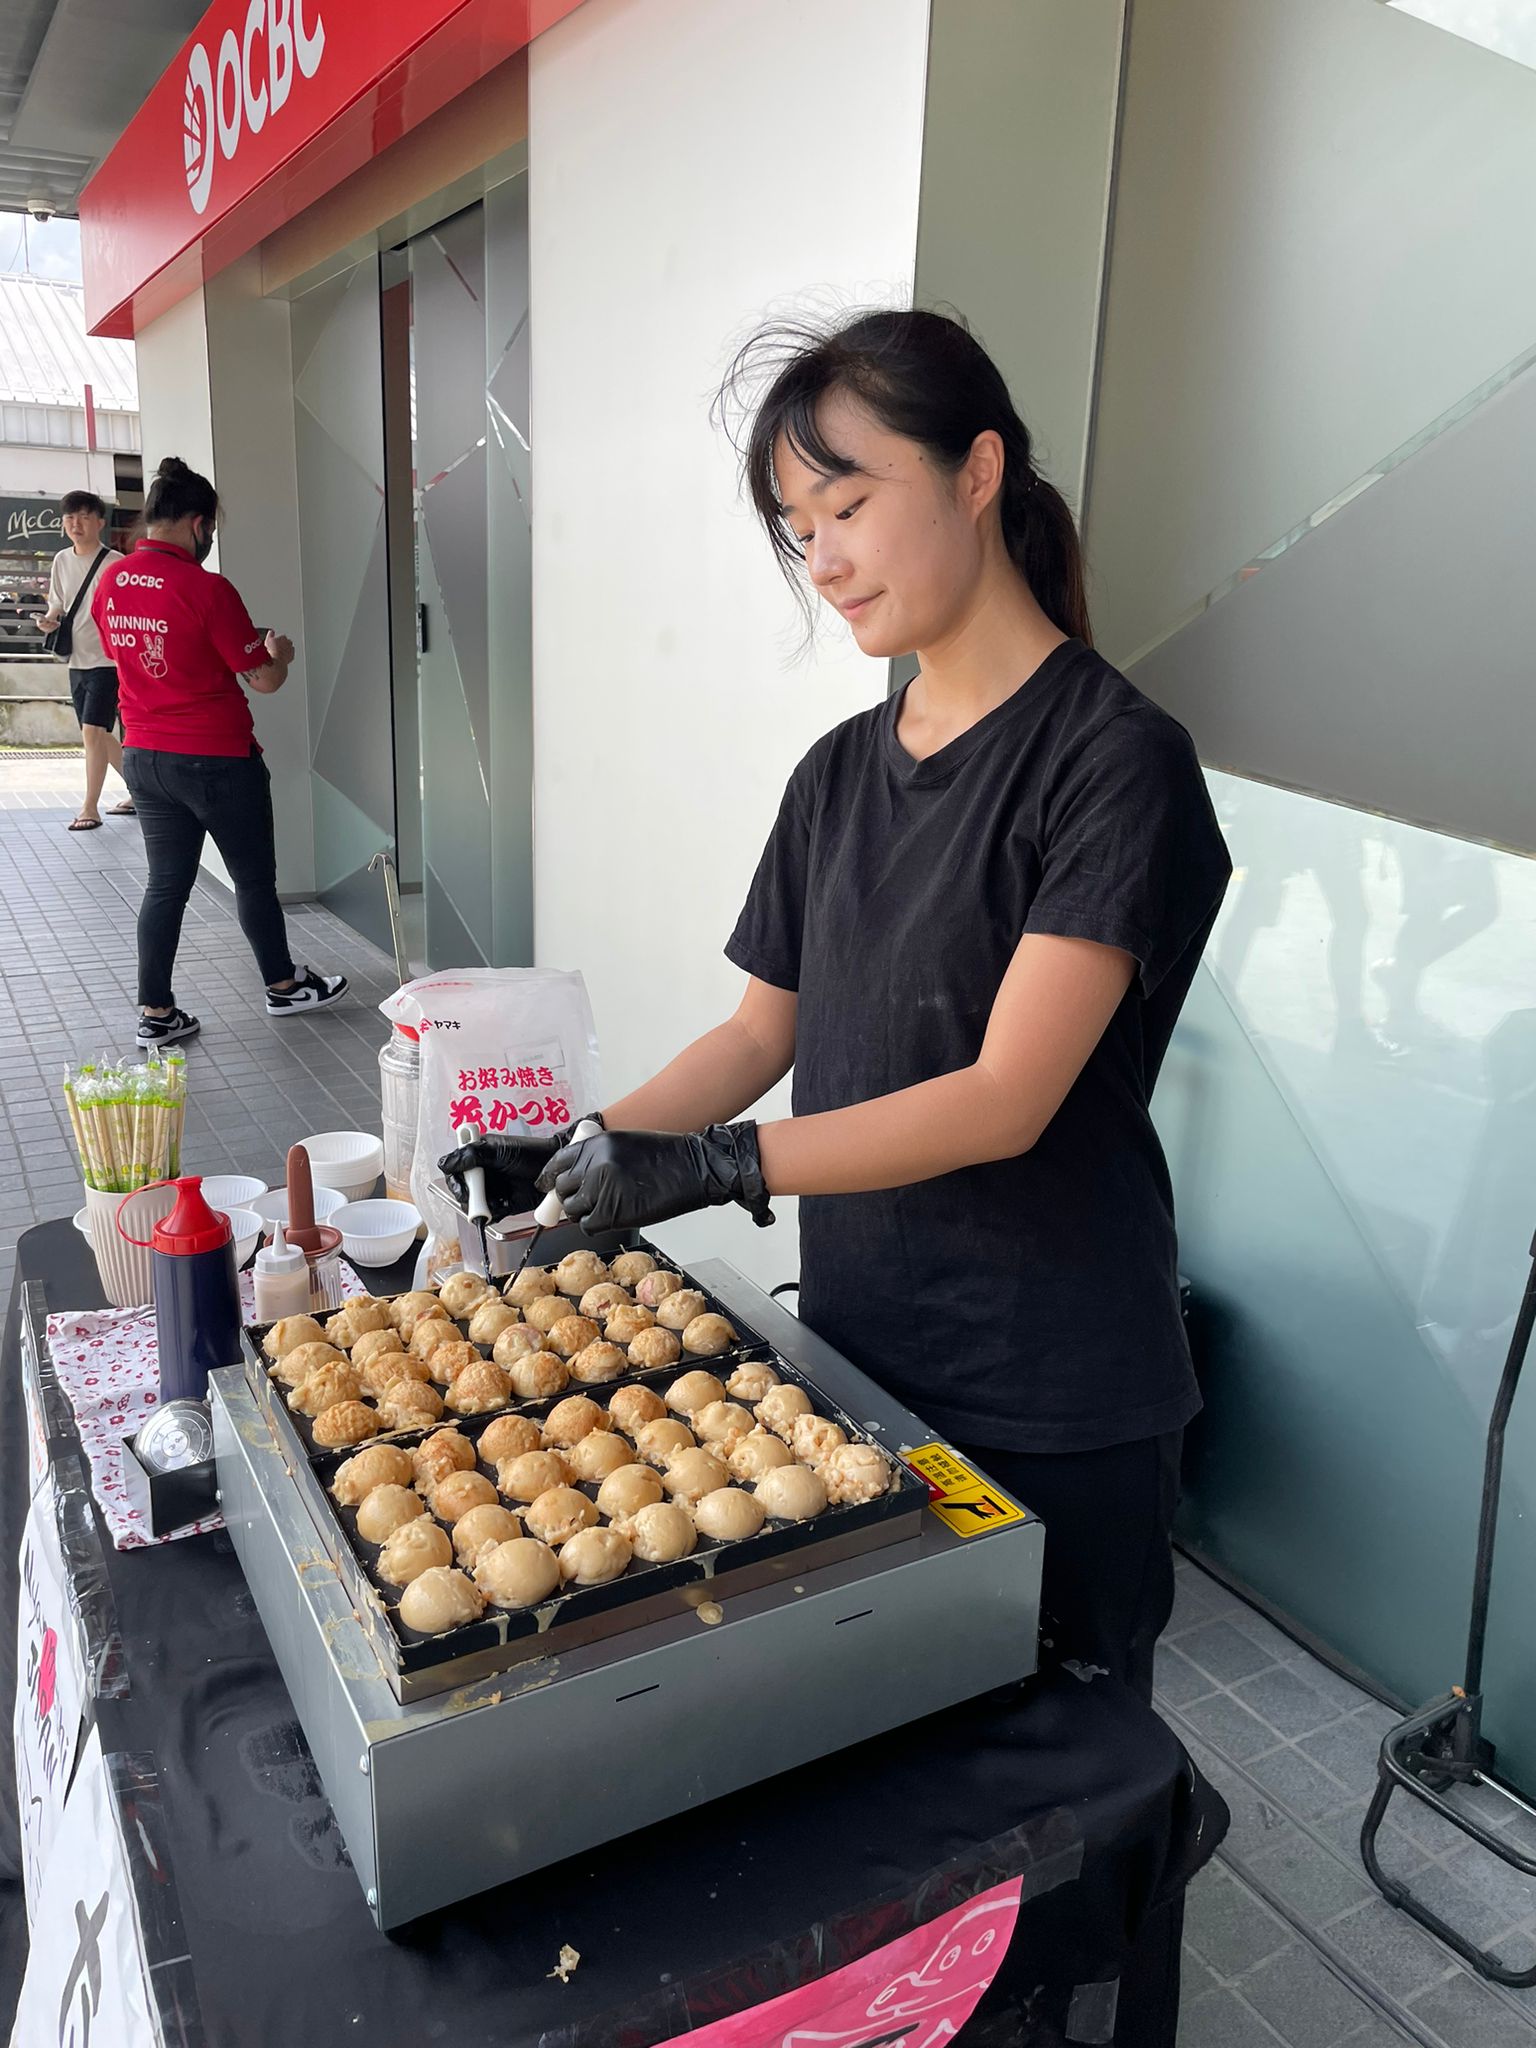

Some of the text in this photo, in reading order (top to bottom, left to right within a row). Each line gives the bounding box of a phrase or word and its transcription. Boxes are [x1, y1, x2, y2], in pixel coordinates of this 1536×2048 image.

[216, 0, 326, 160] OCBC
[129, 573, 165, 590] OCBC
[106, 596, 115, 611] A
[107, 615, 169, 634] WINNING
[110, 633, 137, 648] DUO
[434, 1020, 461, 1031] ヤマキ
[457, 1066, 554, 1092] お好み焼き
